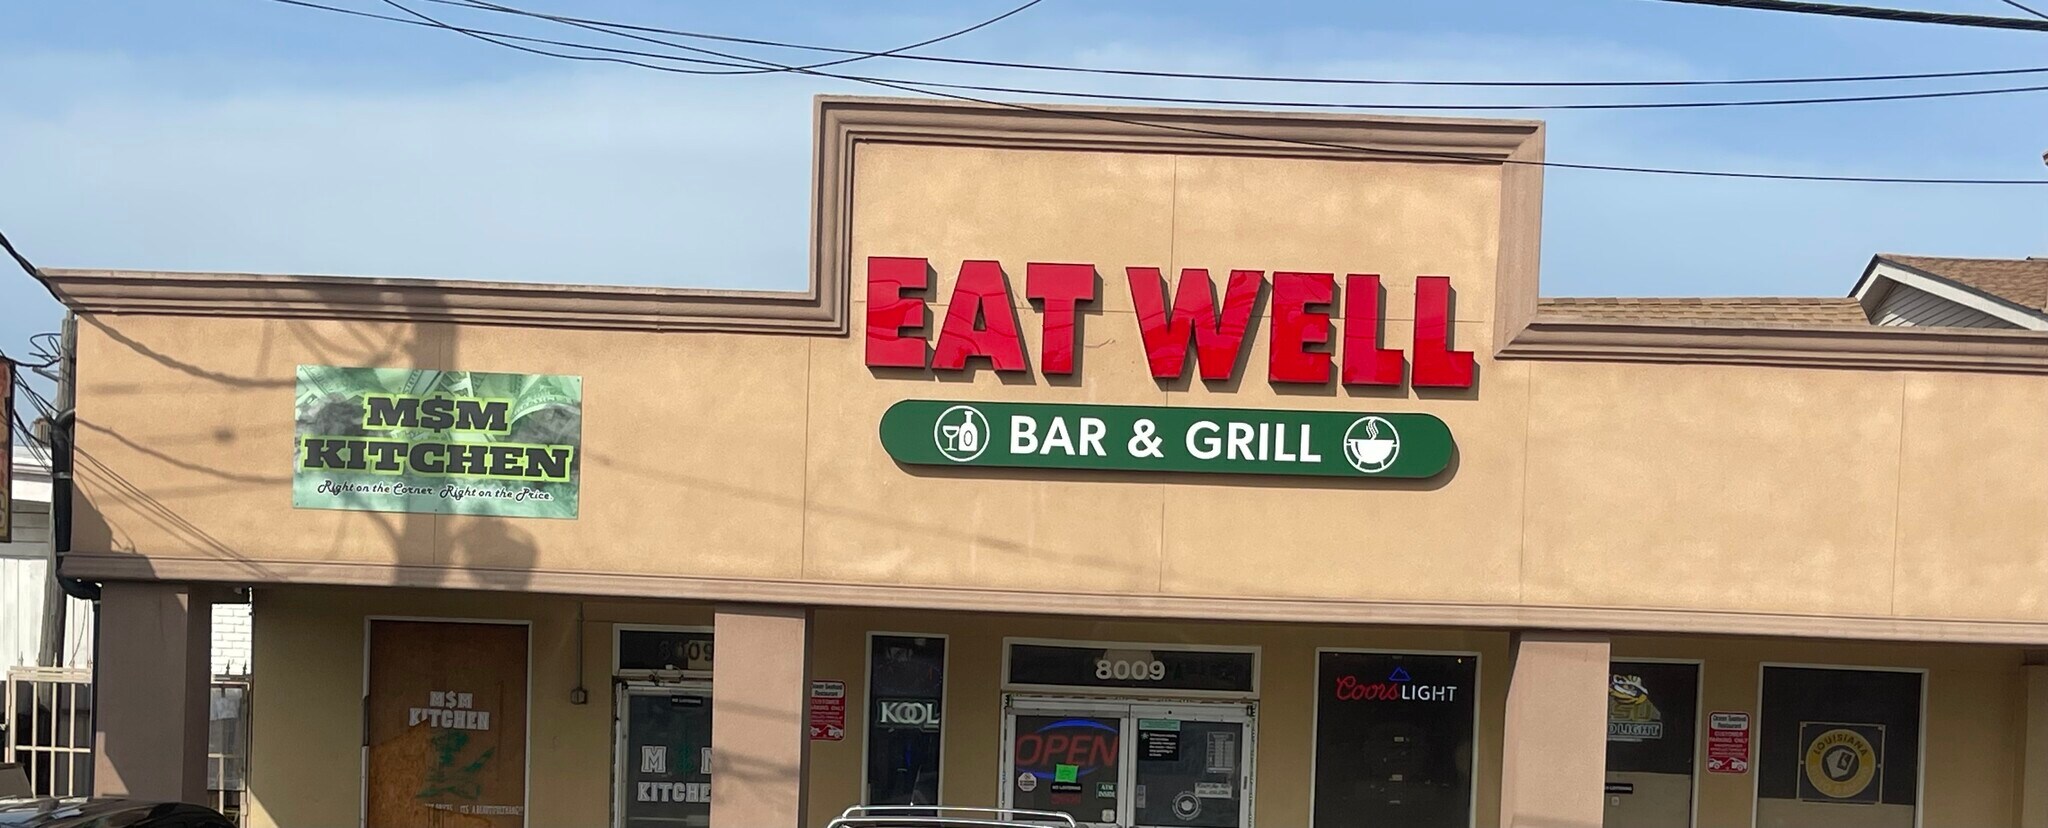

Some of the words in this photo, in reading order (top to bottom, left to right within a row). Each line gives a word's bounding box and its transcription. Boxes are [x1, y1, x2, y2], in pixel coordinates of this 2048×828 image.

[865, 256, 1099, 376] EAT
[1125, 266, 1475, 388] WELL
[366, 394, 509, 434] M$M
[1009, 413, 1108, 458] BAR
[1126, 417, 1165, 460] &
[1185, 419, 1322, 464] GRILL
[304, 437, 570, 479] KITCHEN
[317, 480, 353, 496] Right
[356, 485, 369, 493] on
[372, 481, 390, 493] the
[439, 485, 476, 501] Right
[478, 489, 492, 498] on
[494, 488, 512, 499] the
[1095, 659, 1166, 681] 8009
[1335, 675, 1399, 701] Coors
[1400, 684, 1458, 702] LIGHT
[408, 707, 490, 731] KITCHEN
[879, 701, 940, 725] KOOL
[1616, 723, 1660, 736] LIGHT
[1014, 733, 1119, 767] OPEN
[1813, 733, 1868, 757] LOUISIANA
[637, 781, 710, 803] KITCHE
